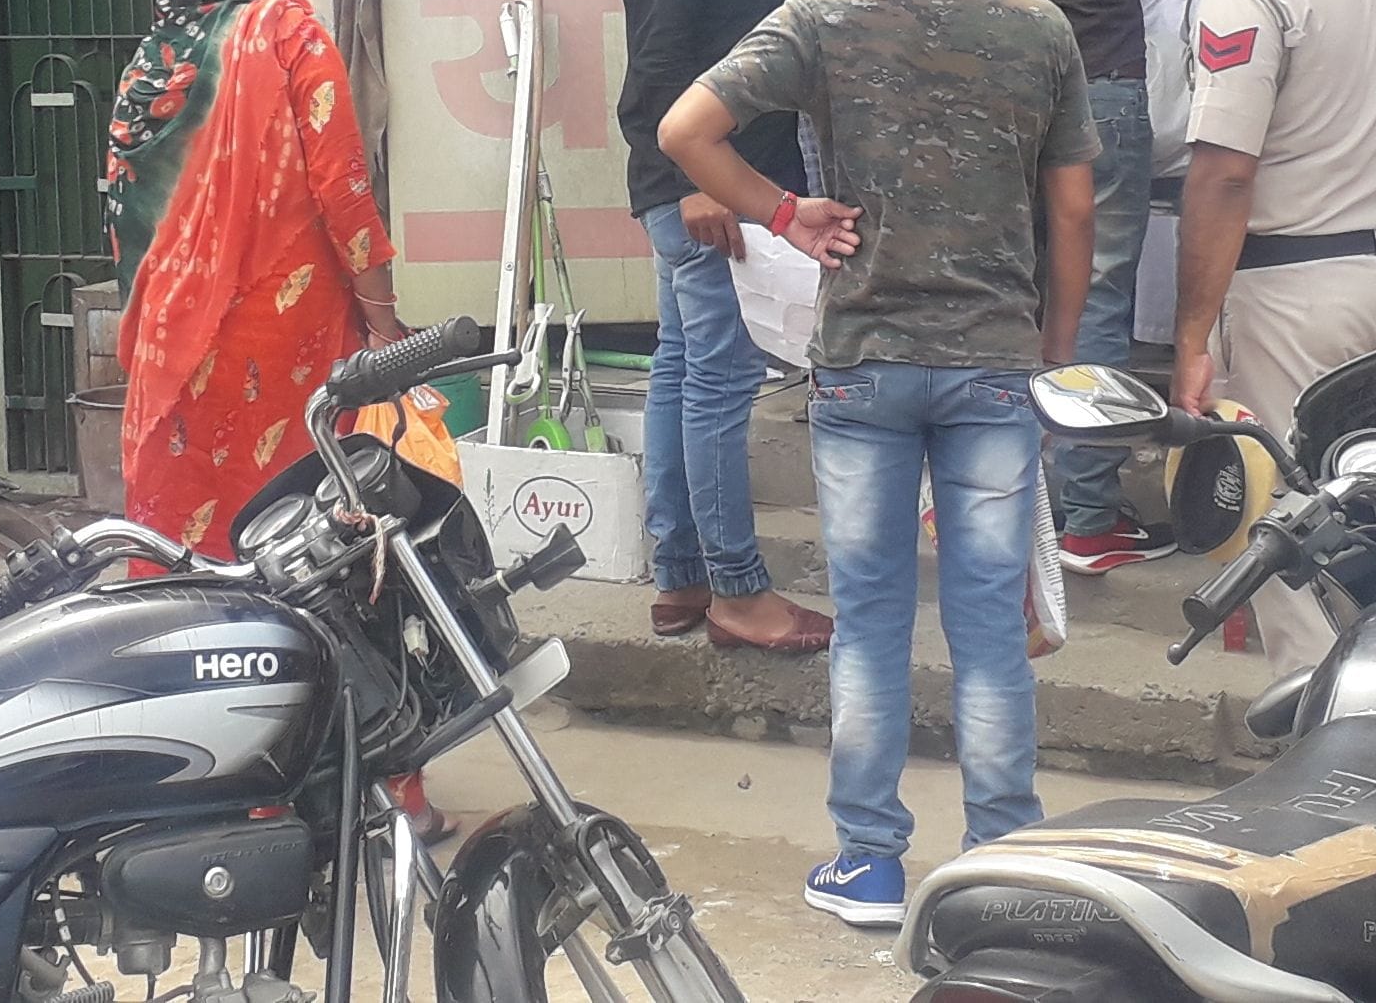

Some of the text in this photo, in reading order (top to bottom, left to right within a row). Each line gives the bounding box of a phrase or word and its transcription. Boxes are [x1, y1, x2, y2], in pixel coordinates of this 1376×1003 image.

[521, 491, 585, 523] Ayur
[195, 651, 280, 679] Hero
[980, 898, 1123, 923] PLATIN
